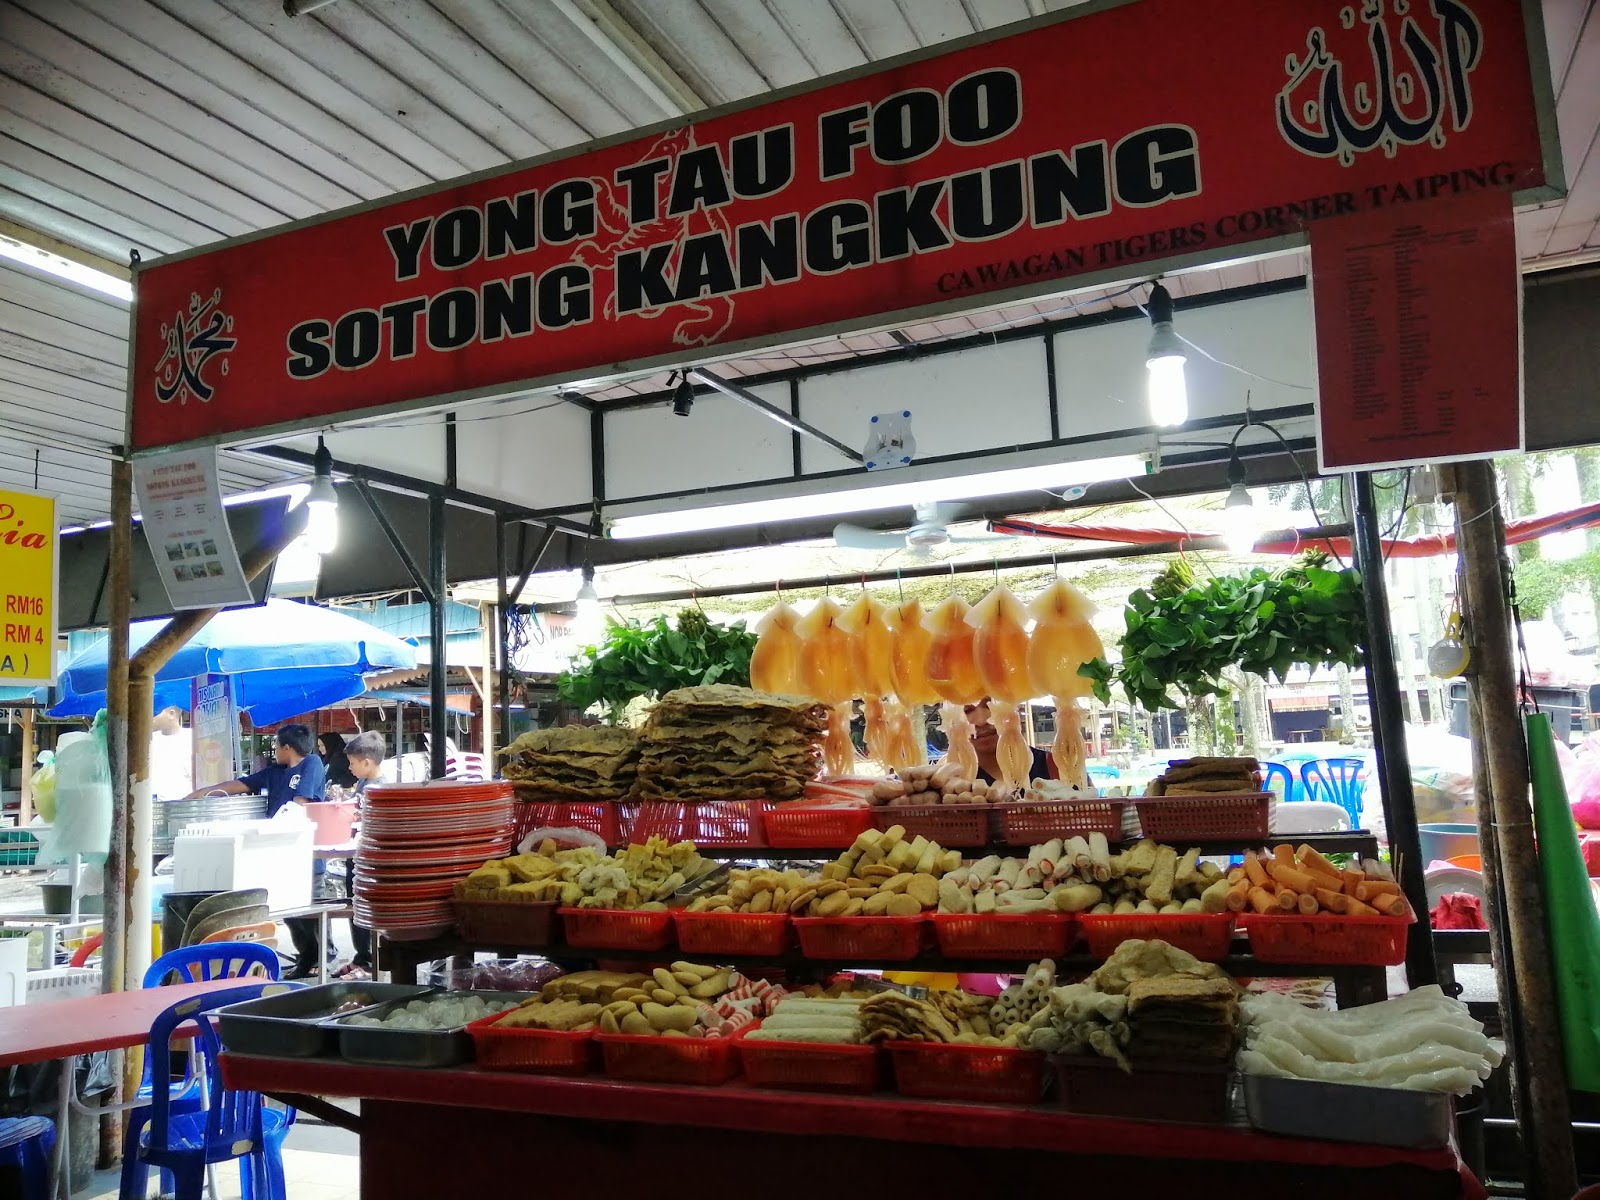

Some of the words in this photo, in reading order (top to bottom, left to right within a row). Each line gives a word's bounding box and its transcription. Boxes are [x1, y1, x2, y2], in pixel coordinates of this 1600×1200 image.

[383, 177, 597, 281] YONG
[614, 122, 795, 226] TAU
[818, 67, 1023, 182] FOO
[937, 246, 1085, 294] CAWAGAN
[1091, 220, 1207, 266] TIGERS
[1215, 191, 1356, 238] CORNER
[1366, 161, 1516, 209] TAIPING
[286, 262, 594, 380] SOTONG
[614, 123, 1202, 316] KANGKUNG
[5, 624, 30, 643] RM
[35, 627, 43, 645] 4
[6, 594, 43, 616] RM16
